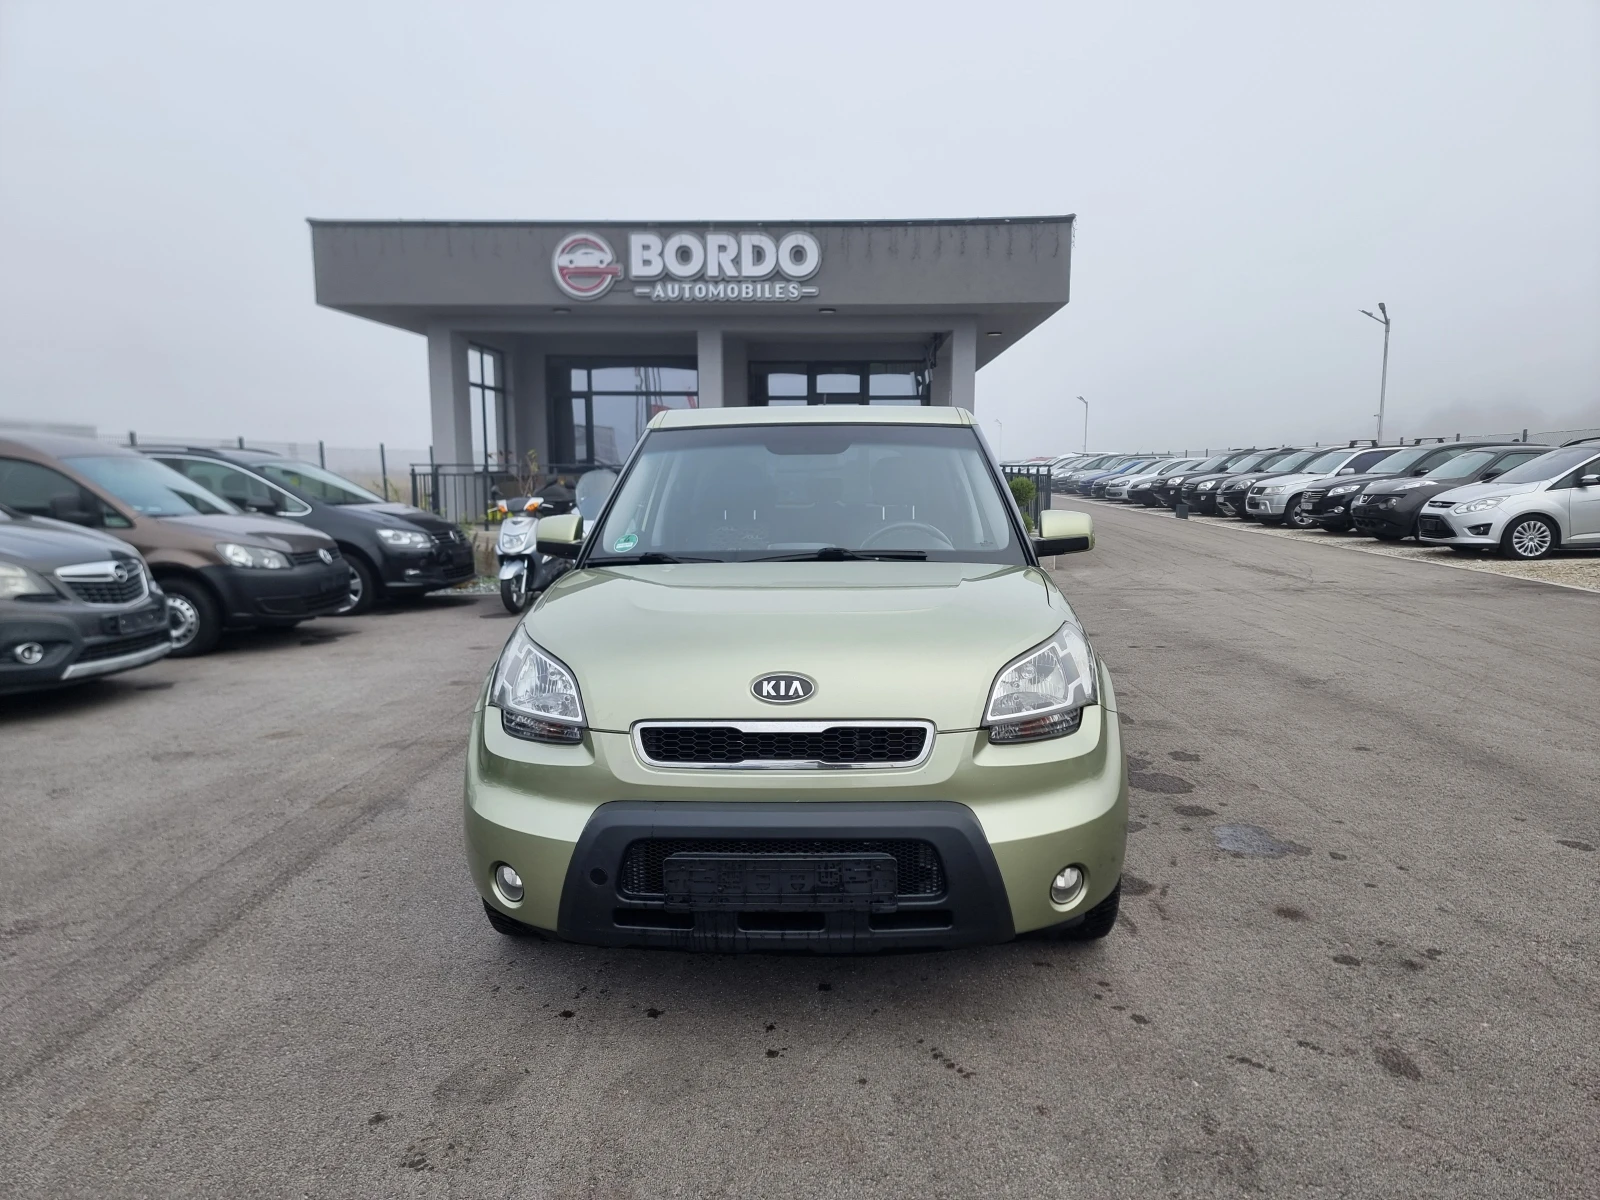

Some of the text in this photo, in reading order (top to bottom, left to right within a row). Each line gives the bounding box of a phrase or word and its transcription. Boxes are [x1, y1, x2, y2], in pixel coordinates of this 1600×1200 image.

[631, 233, 819, 277] BORDO
[653, 283, 799, 298] AUTOMOBILES
[762, 680, 804, 696] KIA
